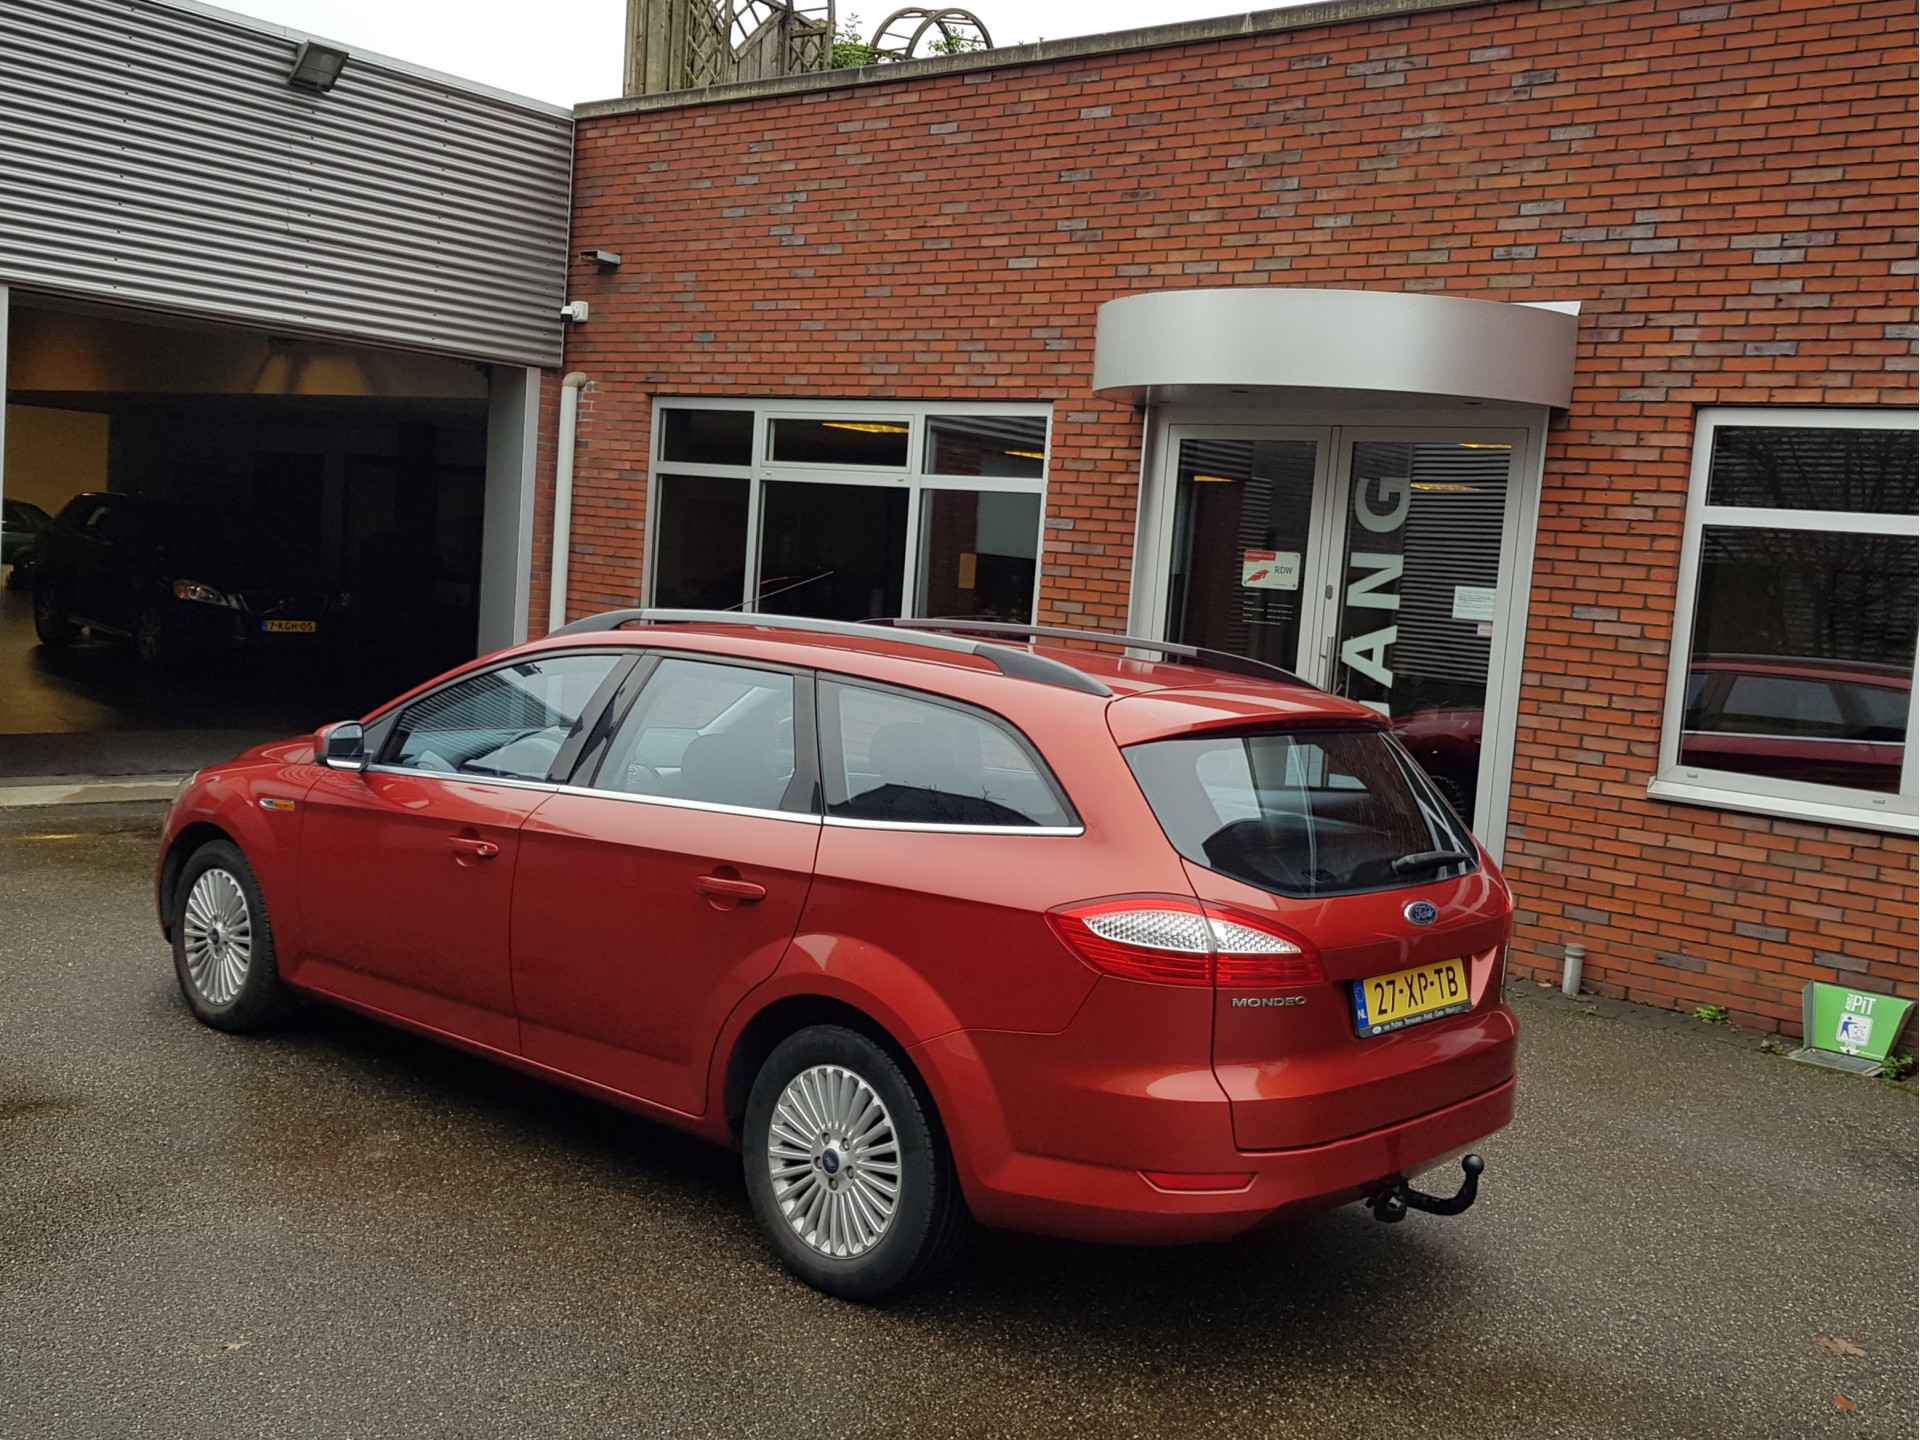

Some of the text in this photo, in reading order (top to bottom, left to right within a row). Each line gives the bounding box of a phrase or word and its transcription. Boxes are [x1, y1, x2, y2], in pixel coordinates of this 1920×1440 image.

[1341, 476, 1411, 717] ANG
[1231, 995, 1306, 1008] MONDEO
[1374, 966, 1458, 1016] 27-XP-TB
[1851, 994, 1877, 1015] PIT
